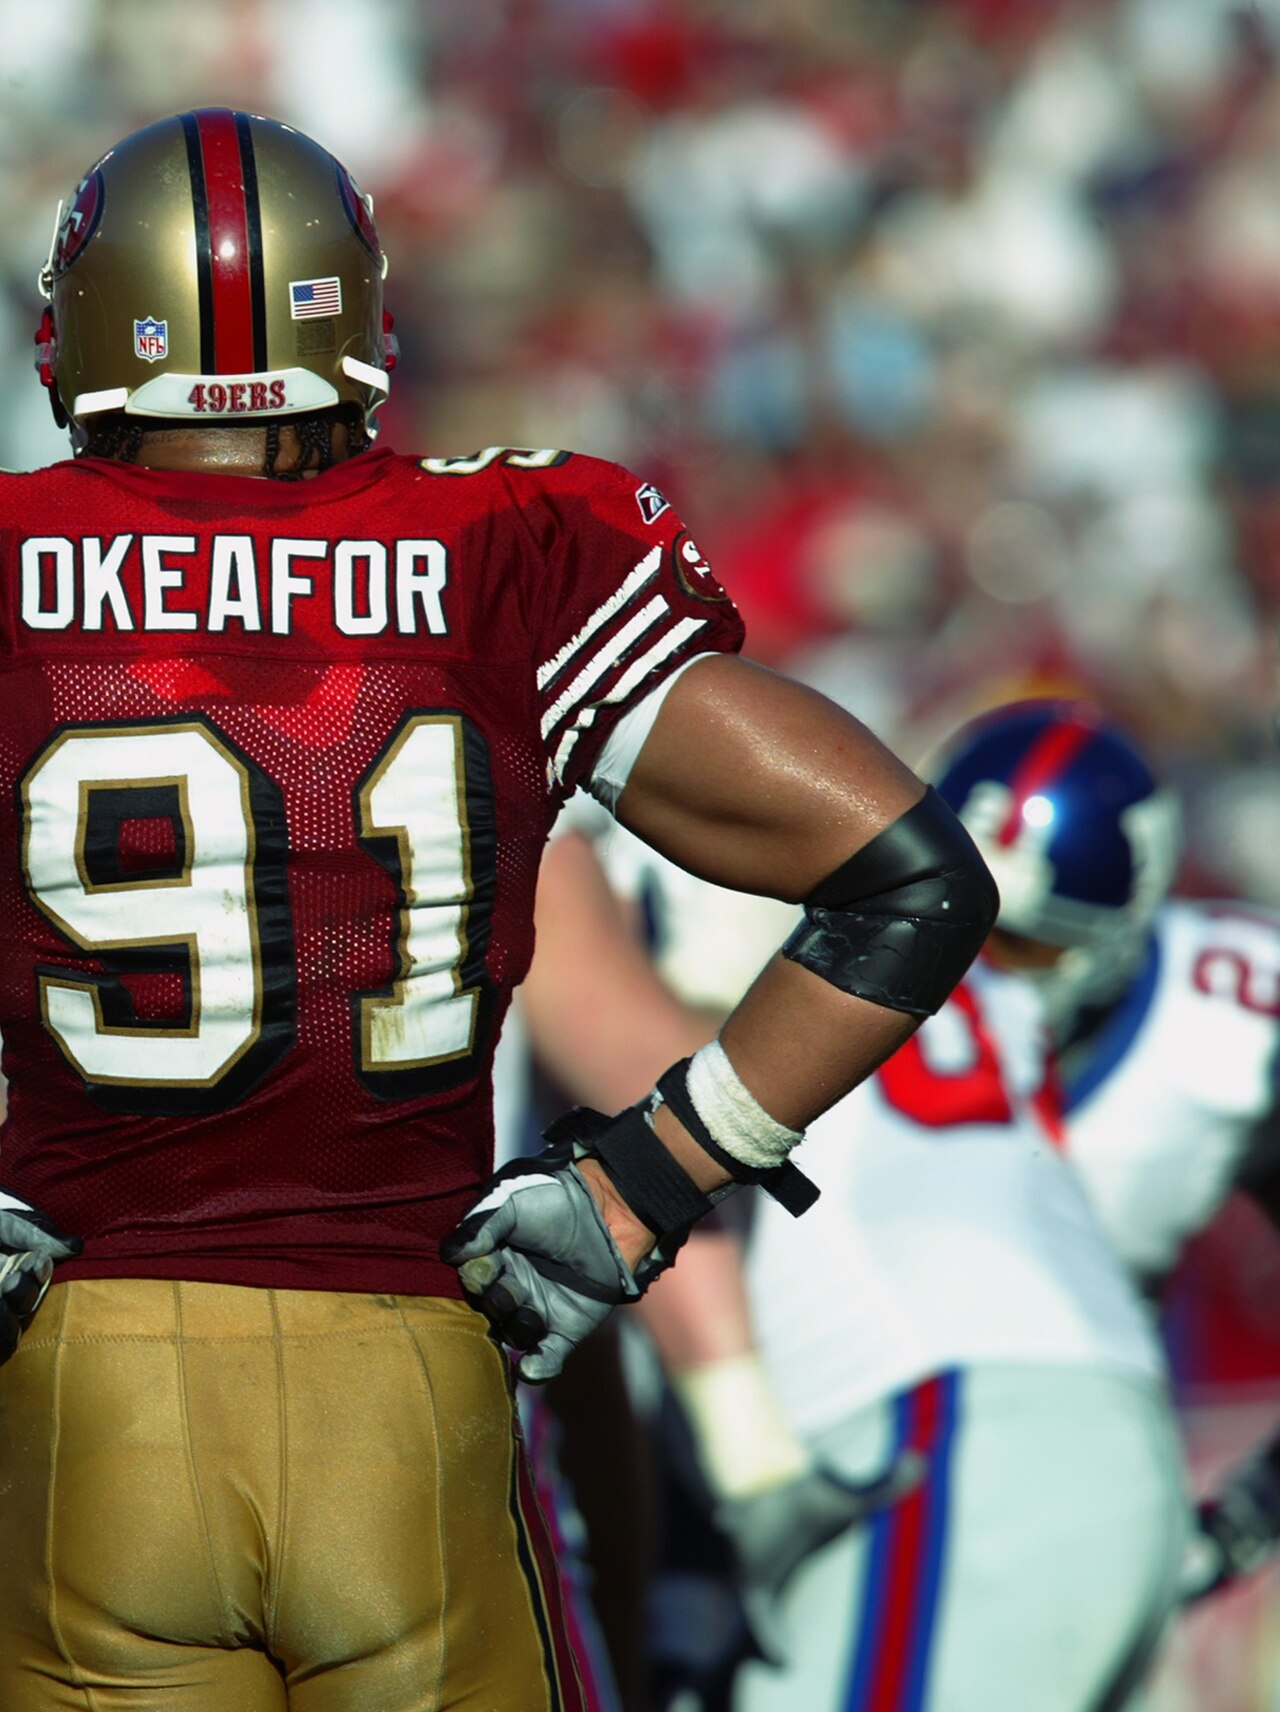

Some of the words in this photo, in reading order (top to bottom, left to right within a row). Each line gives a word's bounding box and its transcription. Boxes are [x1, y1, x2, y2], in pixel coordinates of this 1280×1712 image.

[138, 336, 166, 355] NFL
[187, 379, 287, 413] 49ERS
[19, 533, 451, 638] OKEAFOR
[17, 708, 497, 1116] 91
